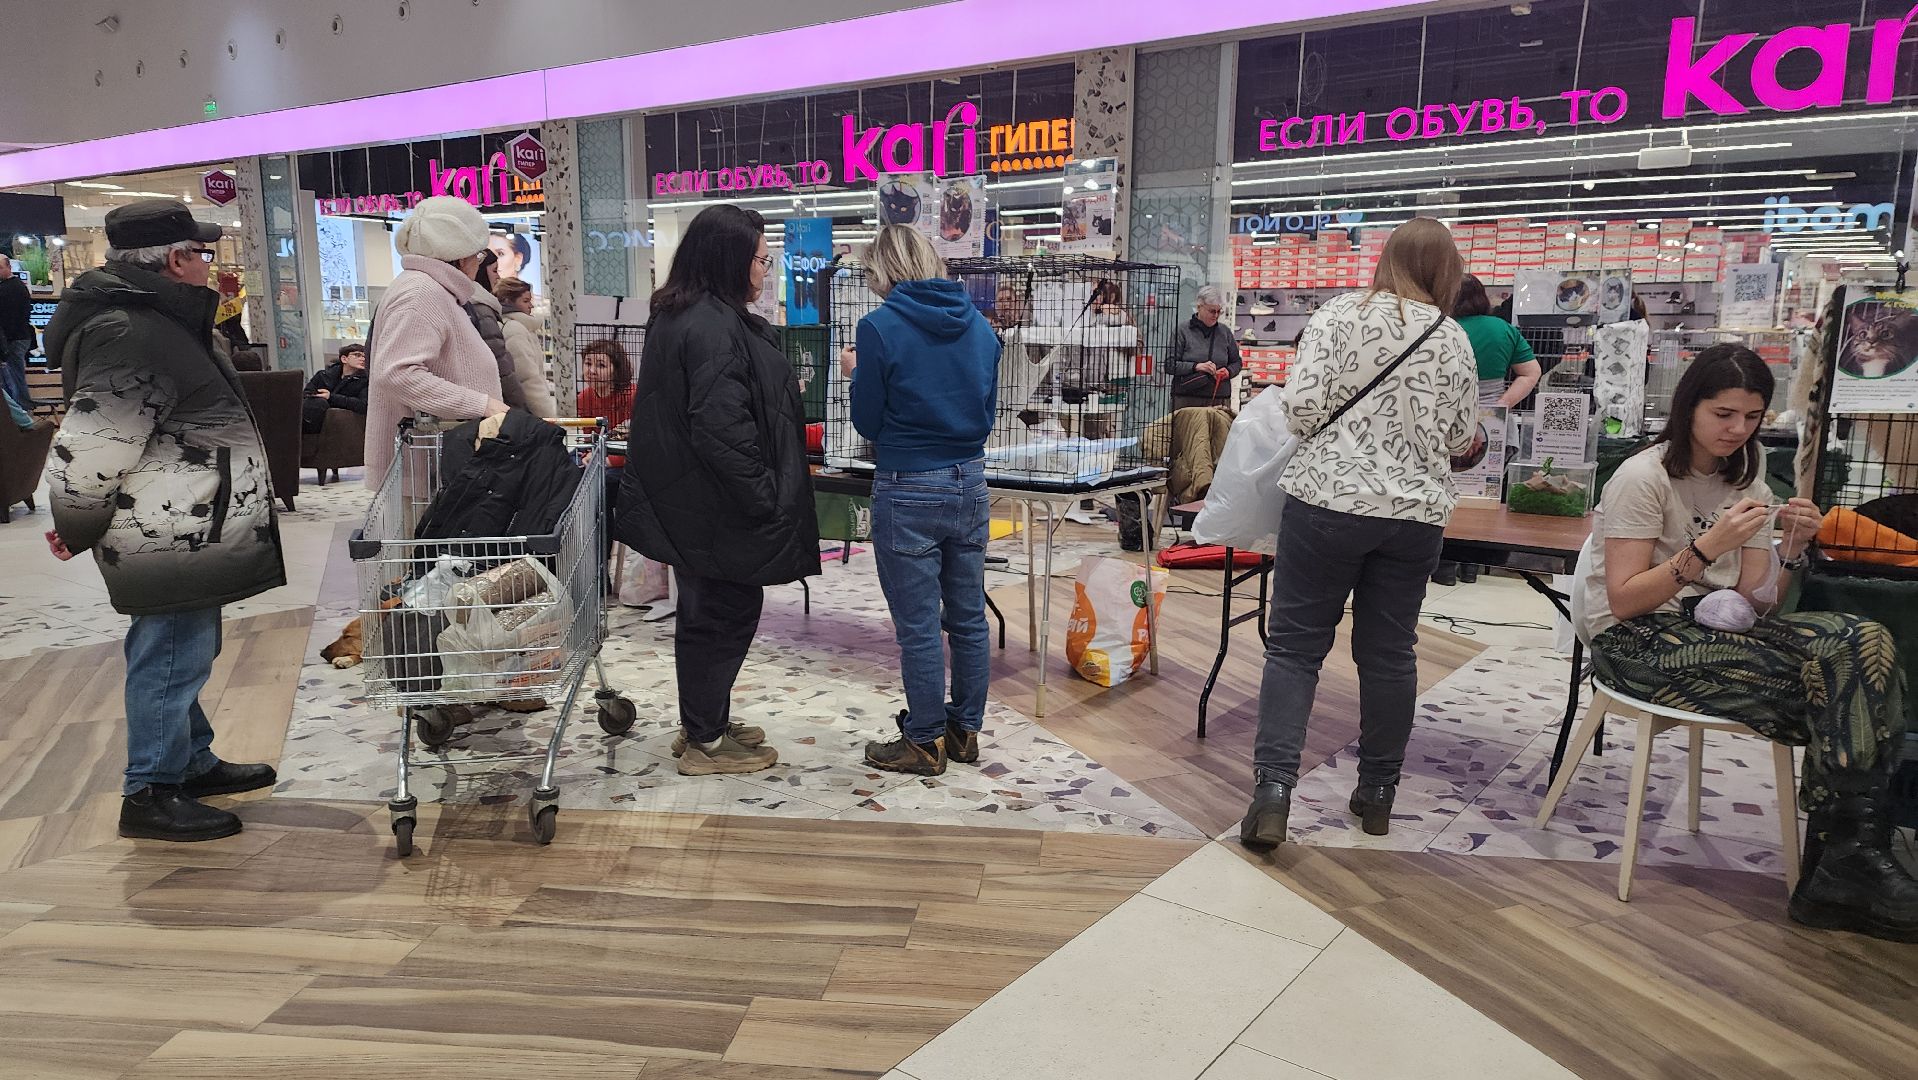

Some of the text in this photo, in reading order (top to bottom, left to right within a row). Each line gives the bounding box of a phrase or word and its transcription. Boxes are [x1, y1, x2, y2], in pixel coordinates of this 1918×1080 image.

[1662, 4, 1918, 119] kar
[842, 102, 979, 182] kari
[1260, 86, 1628, 151] ЕСЛИ ОБУВЬ, ТО
[429, 152, 507, 207] kari
[515, 145, 544, 161] kari
[656, 159, 830, 195] ЕСЛИ ОБУВЬ, ТО
[207, 178, 234, 190] kari
